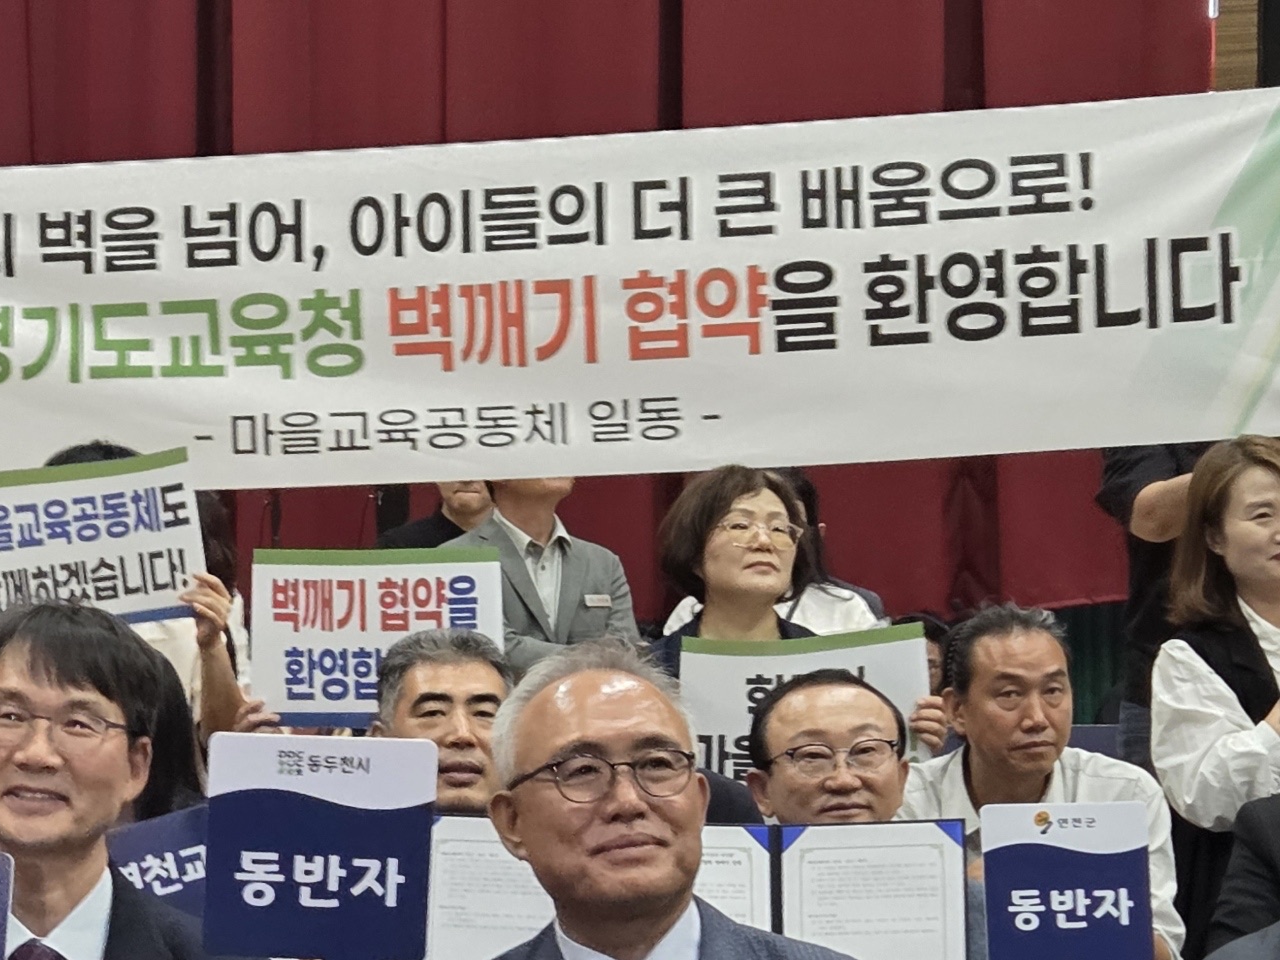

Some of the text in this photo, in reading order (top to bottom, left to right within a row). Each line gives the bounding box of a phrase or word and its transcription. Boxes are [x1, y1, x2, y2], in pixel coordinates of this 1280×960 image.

[38, 205, 160, 276] 벽을
[183, 199, 328, 271] 넘어,
[351, 180, 607, 258] 아이들의
[631, 175, 692, 243] 더
[715, 170, 777, 238] 큰
[800, 151, 1096, 231] 배움으로!
[387, 274, 600, 372] 벽깨기
[621, 258, 840, 362] 협약을
[863, 231, 1242, 349] 환영합니다
[230, 402, 569, 457] 마을교육공동체
[587, 396, 683, 444] 일동
[271, 575, 479, 633] 벽깨기 협약을
[307, 754, 371, 775] 동두천시
[233, 850, 406, 908] 동반자
[1007, 888, 1135, 929] 동반자
